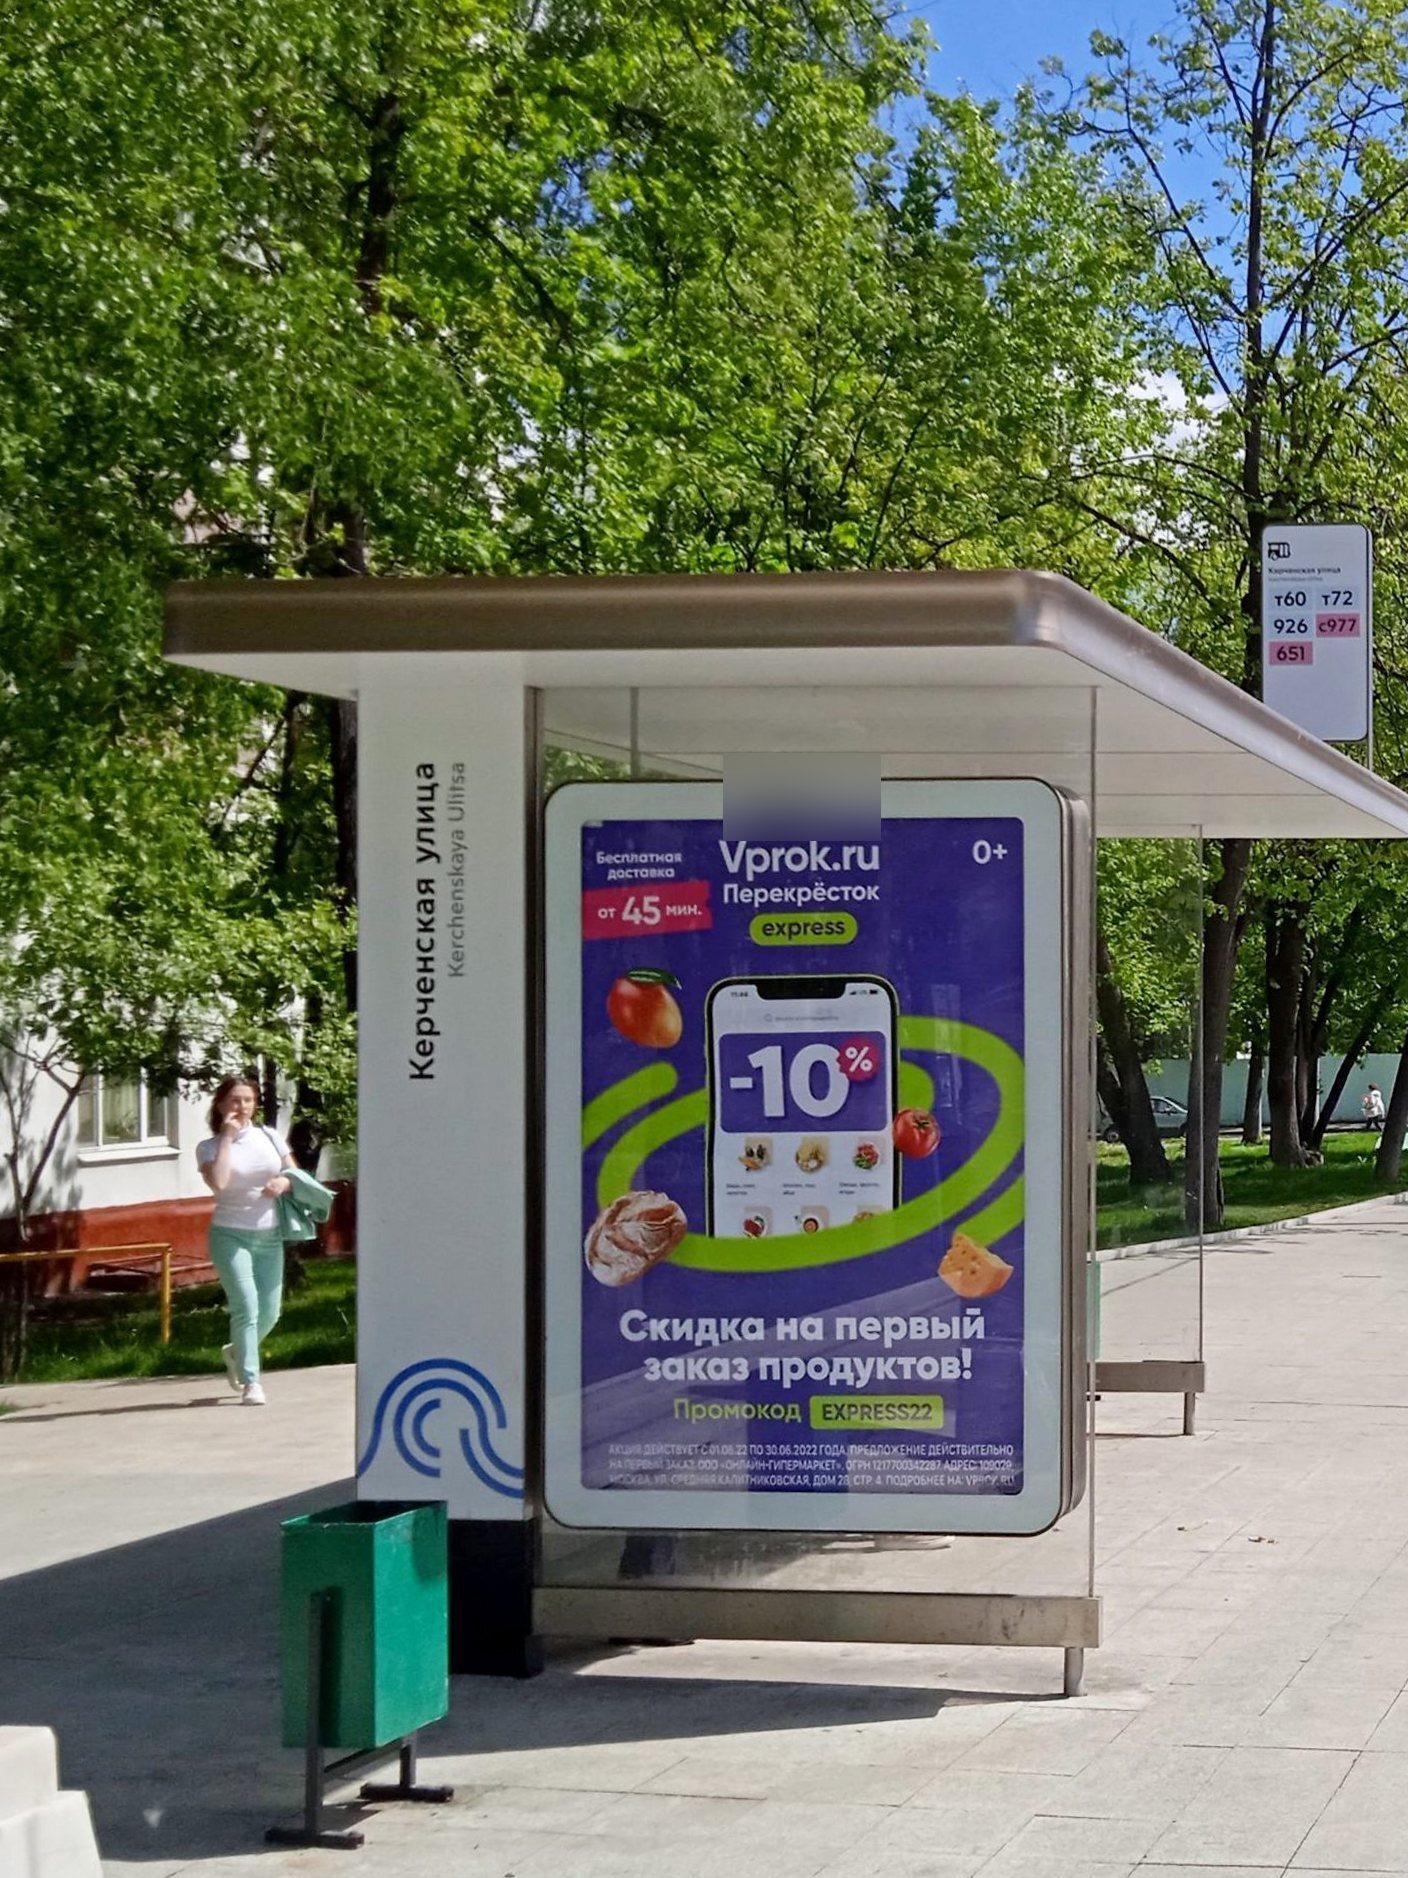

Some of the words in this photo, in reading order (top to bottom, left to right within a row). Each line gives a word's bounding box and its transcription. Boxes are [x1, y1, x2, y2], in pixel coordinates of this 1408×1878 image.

[1274, 591, 1306, 606] т60
[1322, 590, 1353, 606] т72
[1274, 618, 1308, 634] 926
[1318, 618, 1357, 632] с977
[1276, 646, 1305, 661] 651
[448, 762, 465, 822] Ulitsa
[416, 763, 441, 864] улица
[596, 852, 682, 865] Бесплатная
[719, 840, 880, 881] Vprok.ru
[972, 840, 1008, 865] 0+
[607, 866, 675, 881] доставка
[448, 829, 469, 977] Kerchenskaya
[723, 882, 880, 908] Перекрёсток
[598, 908, 616, 919] от
[621, 896, 661, 926] 45
[666, 905, 702, 918] мин.
[762, 918, 845, 940] express
[409, 878, 441, 1080] Керченская
[619, 1309, 765, 1346] Скидка
[776, 1318, 823, 1341] на
[836, 1308, 985, 1348] первый
[643, 1356, 750, 1382] заказ
[759, 1348, 972, 1388] продуктов!
[674, 1398, 802, 1424] Промокод
[822, 1403, 933, 1422] EXPRESS22
[750, 1444, 763, 1455] ПО
[766, 1444, 818, 1456] 30.06.2022
[850, 1444, 926, 1456] ПРЕДЛОЖЕНИЕ
[928, 1442, 1014, 1456] ДЕЙСТВИТЕЛЬНО
[846, 1460, 871, 1471] ОГРН
[813, 1475, 836, 1487] ДОМ
[886, 1475, 945, 1488] ПОДРОБНЕЕ
